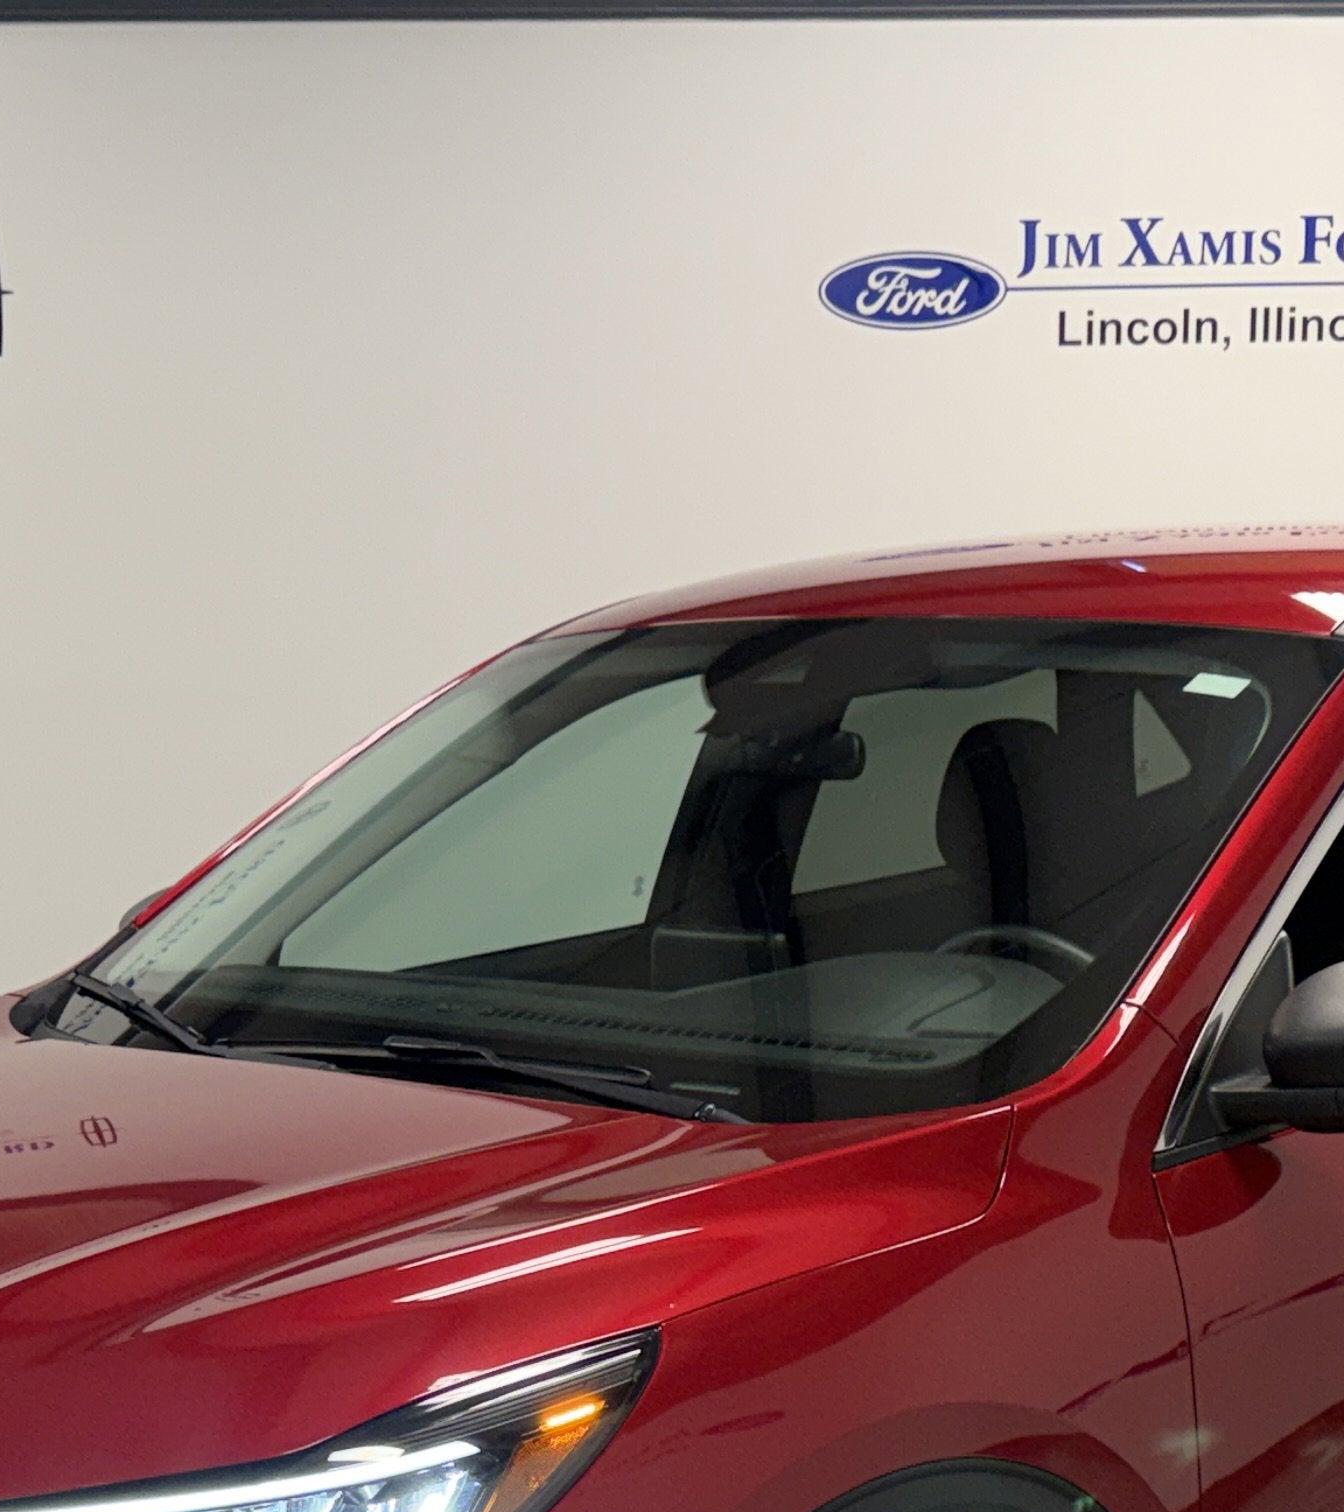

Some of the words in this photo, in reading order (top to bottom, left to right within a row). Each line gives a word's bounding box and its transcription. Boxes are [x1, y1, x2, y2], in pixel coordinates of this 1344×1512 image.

[1017, 220, 1101, 279] JIM
[1121, 218, 1281, 267] XAMIS
[857, 265, 968, 317] Ford
[1058, 308, 1231, 350] Lincoln,
